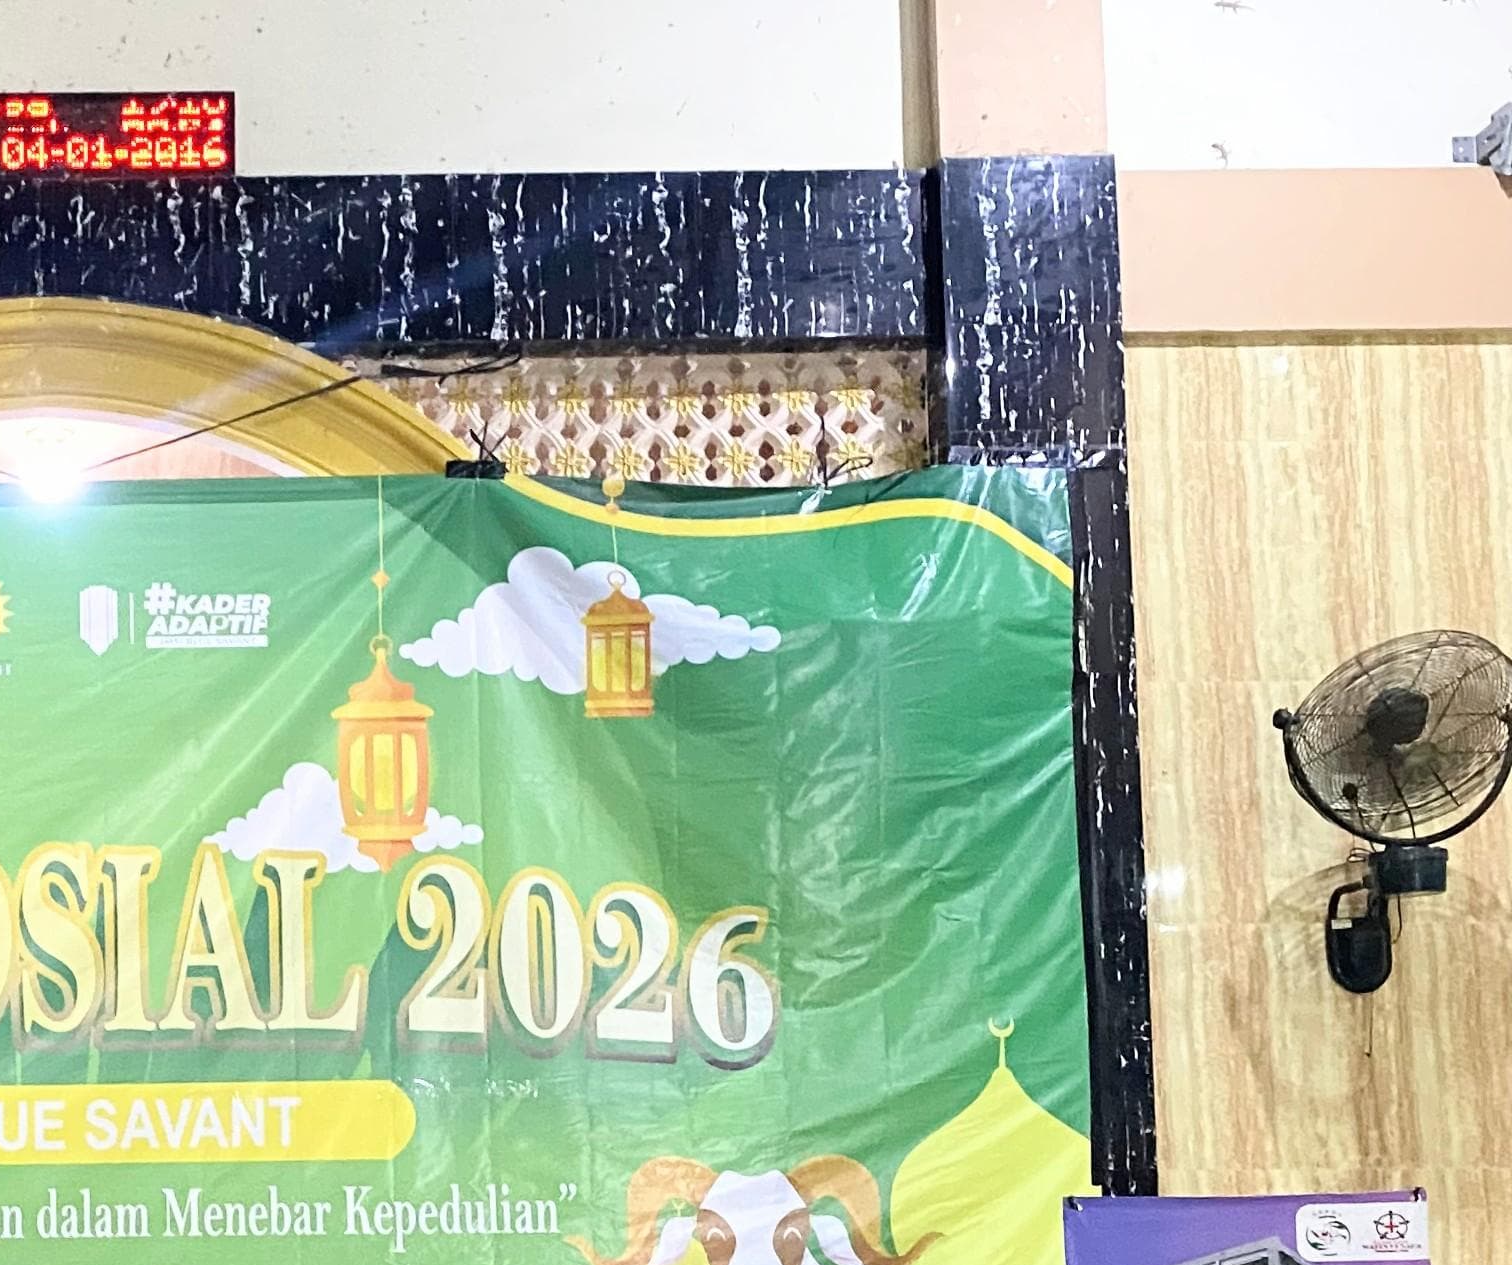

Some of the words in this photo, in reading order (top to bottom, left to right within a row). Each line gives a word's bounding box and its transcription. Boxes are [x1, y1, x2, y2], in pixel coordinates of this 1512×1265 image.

[0, 136, 228, 170] 04-01-2016
[143, 581, 271, 616] #KADER
[146, 614, 269, 635] ADAPTIF
[397, 856, 775, 1070] 2026
[85, 1096, 301, 1150] SAVANT
[37, 1188, 150, 1239] dalam
[162, 1185, 332, 1237] Menebar
